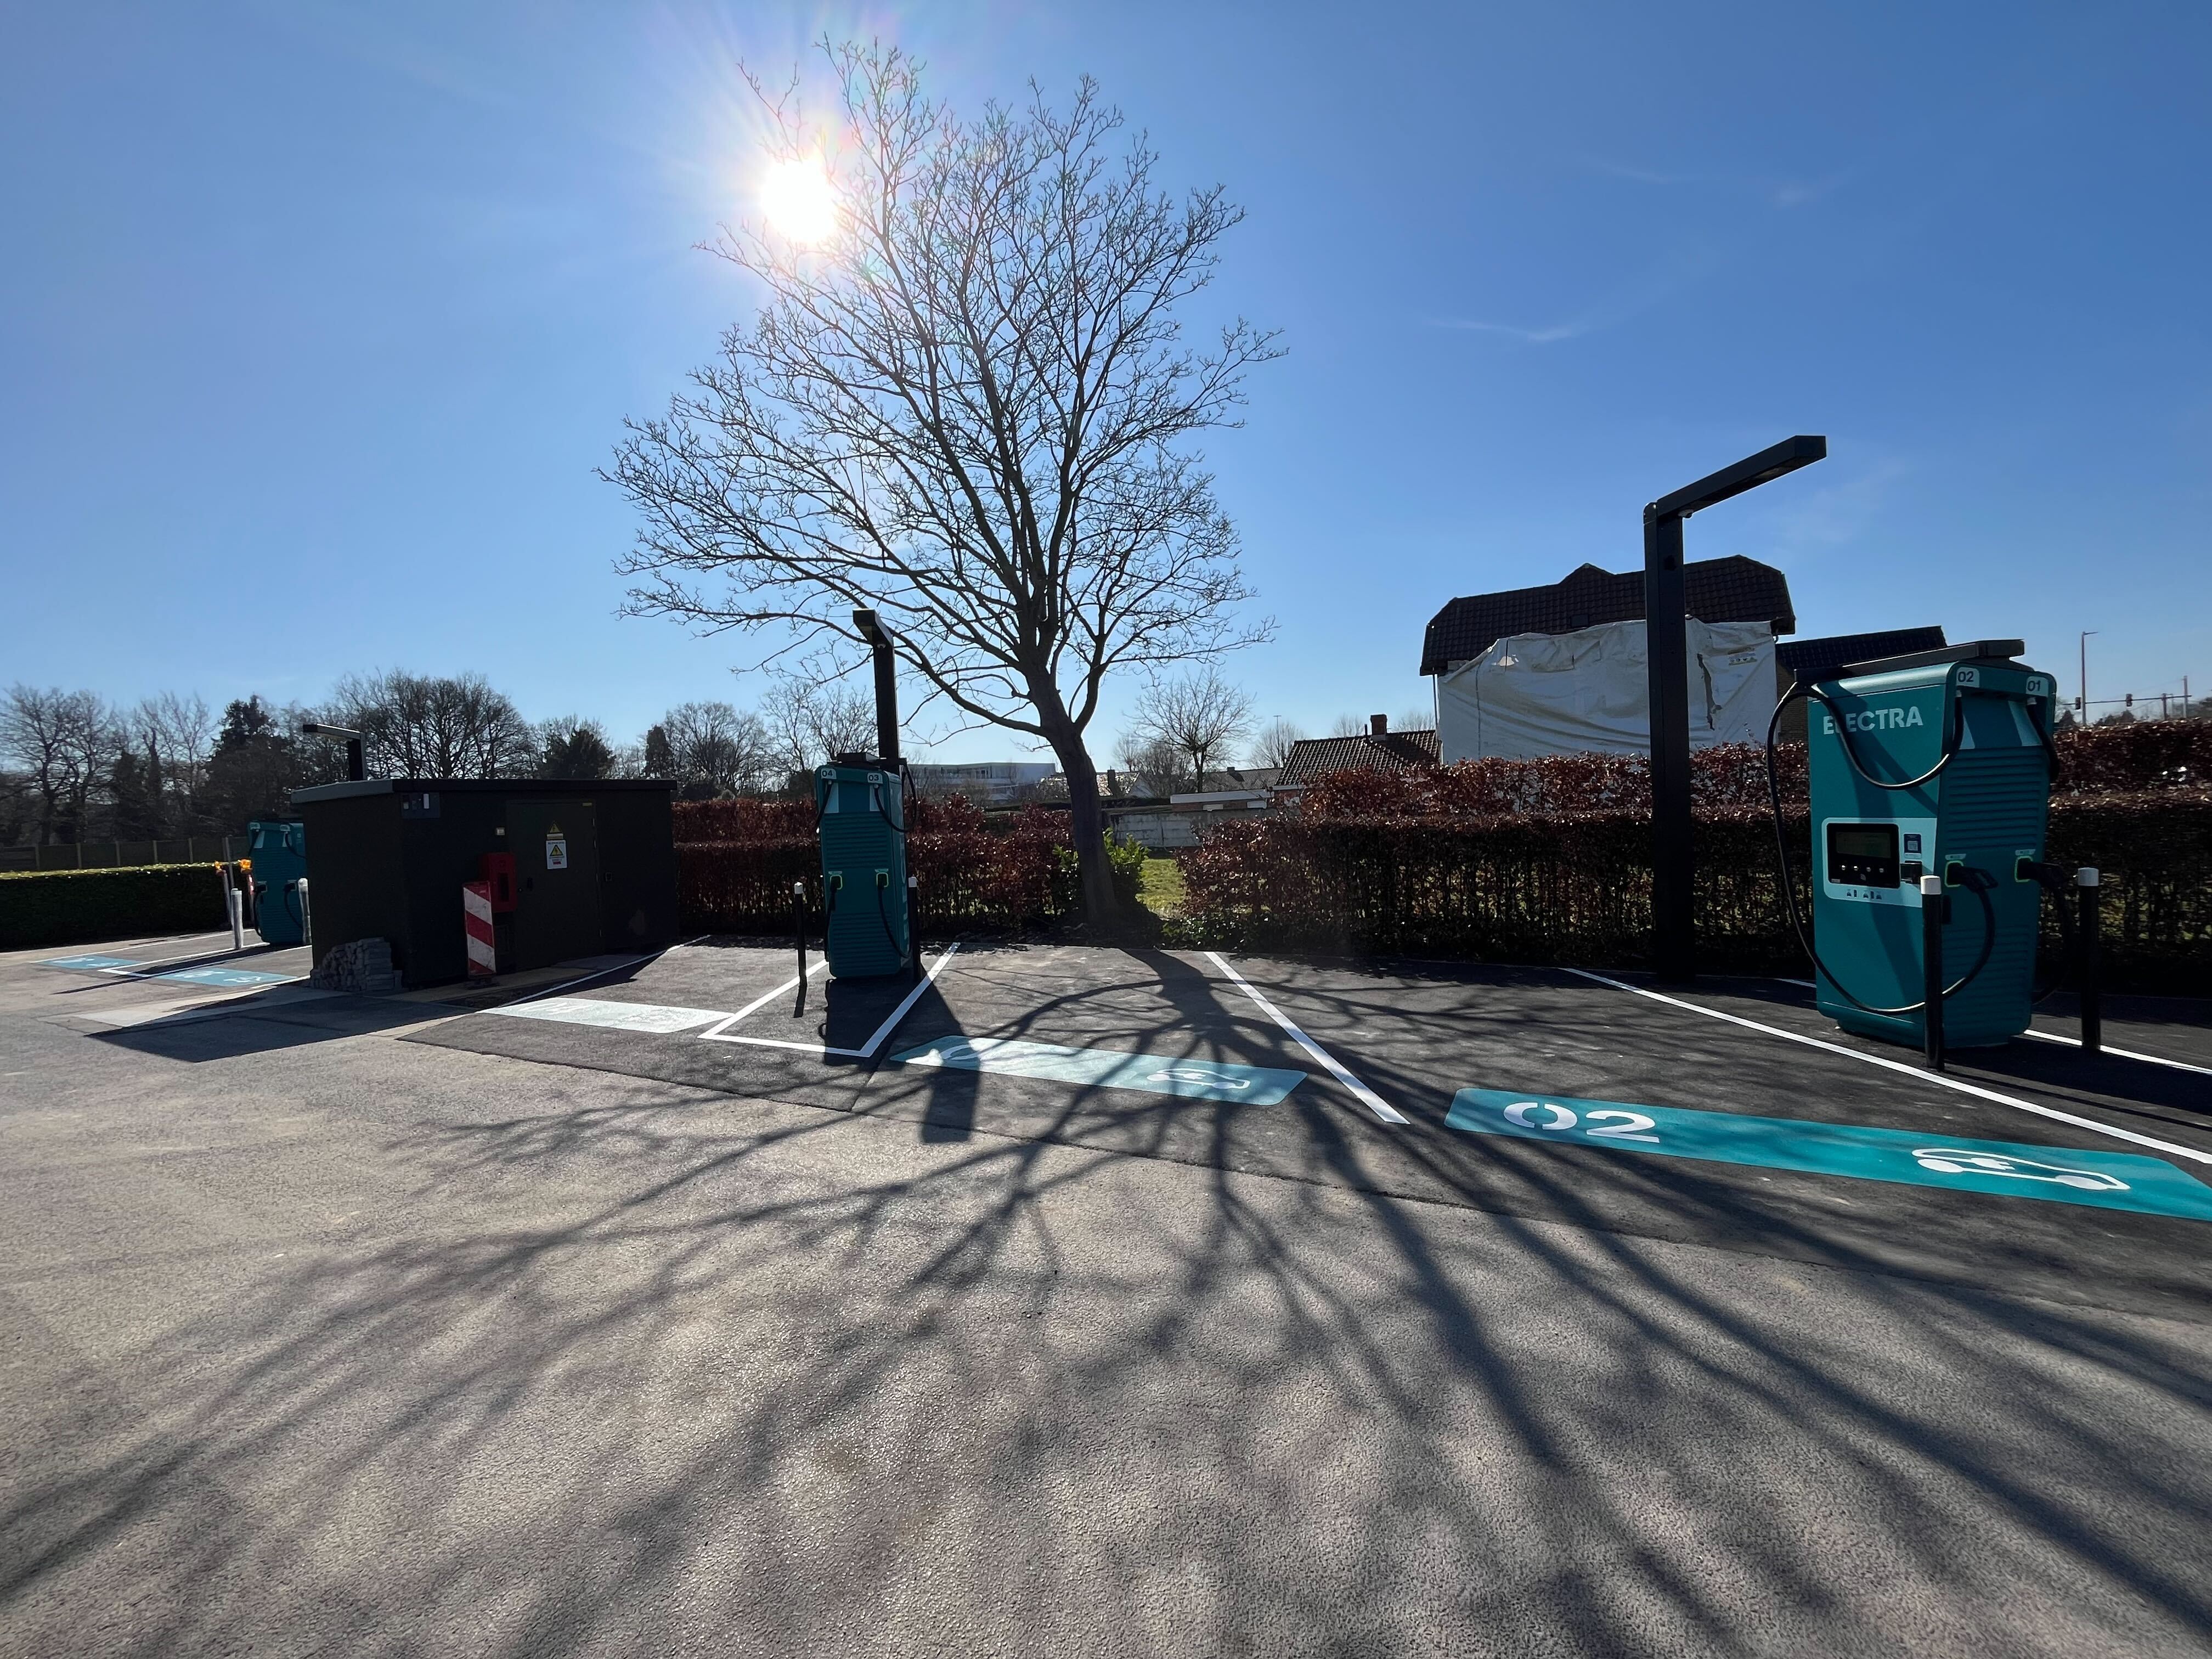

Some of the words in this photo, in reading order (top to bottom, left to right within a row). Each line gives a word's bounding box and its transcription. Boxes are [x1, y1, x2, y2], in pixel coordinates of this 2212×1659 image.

[1957, 671, 1974, 682] 02
[2027, 680, 2041, 692] 01
[1823, 706, 1923, 735] EECTRA
[1503, 1102, 1660, 1143] 02
